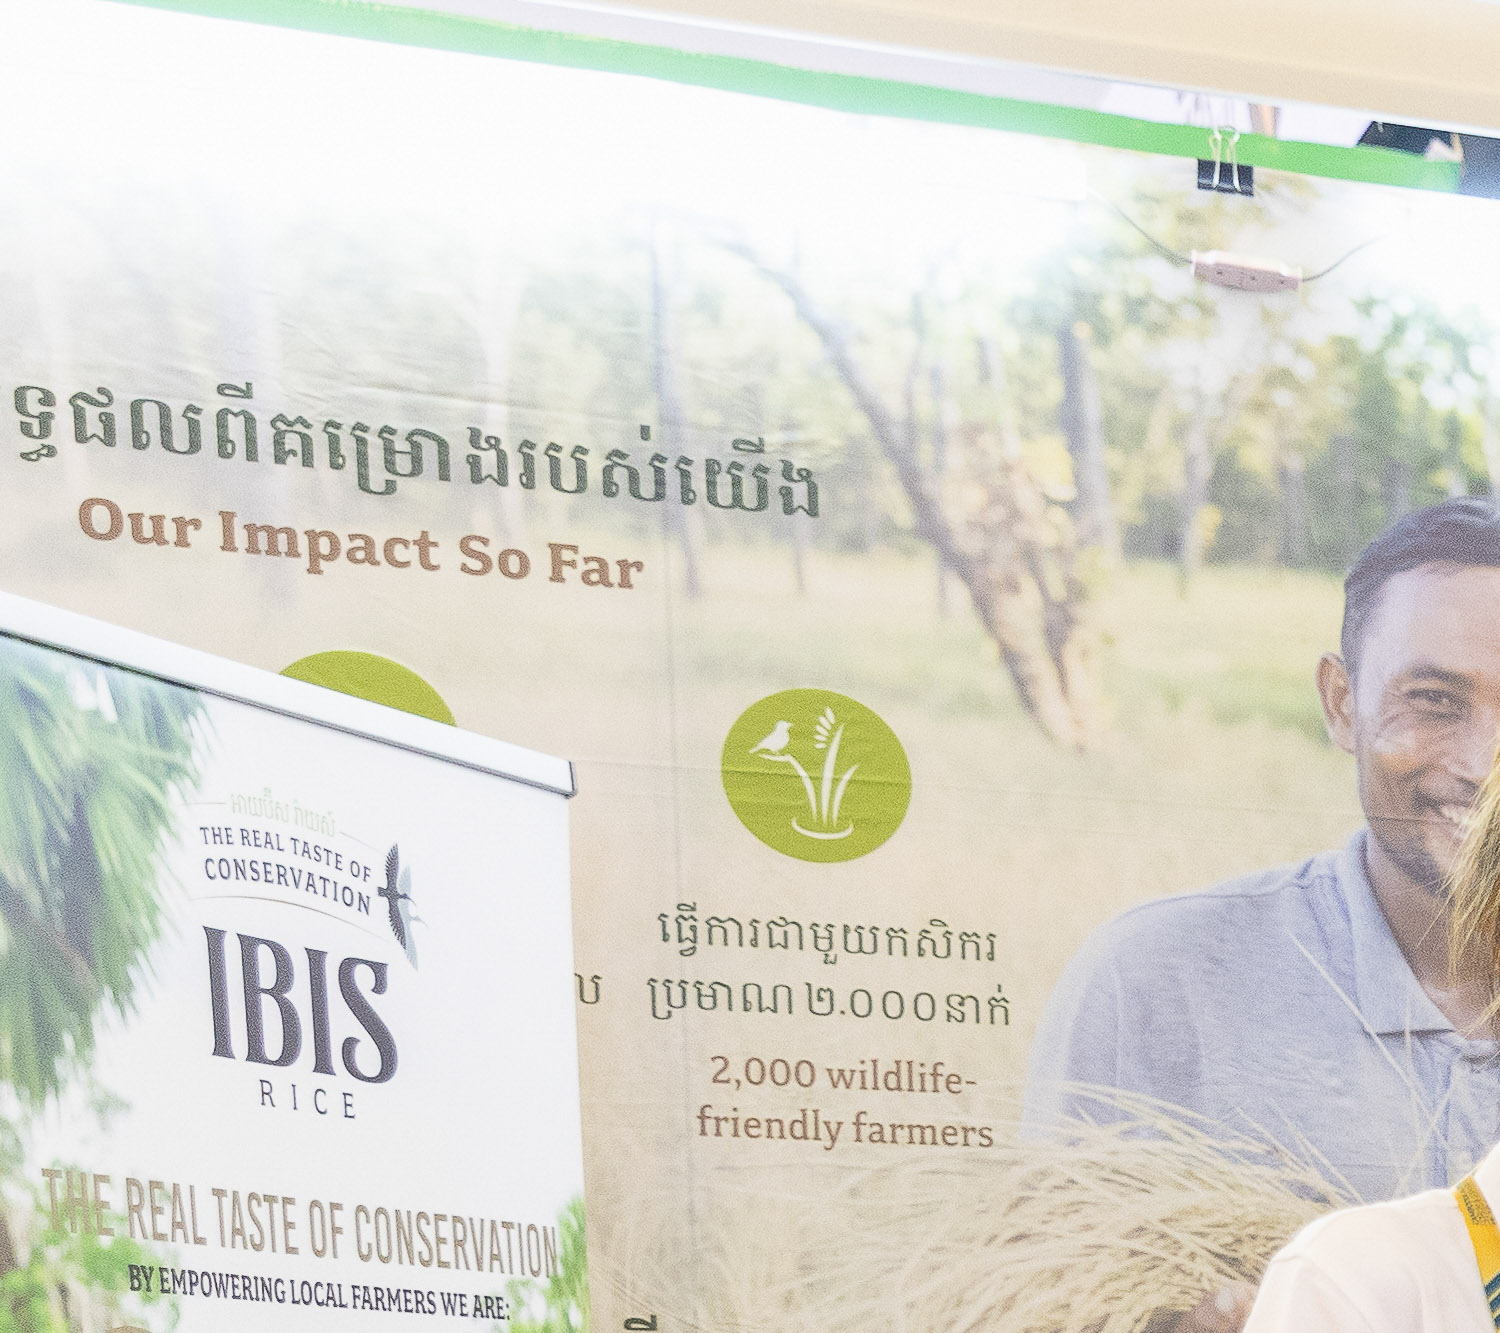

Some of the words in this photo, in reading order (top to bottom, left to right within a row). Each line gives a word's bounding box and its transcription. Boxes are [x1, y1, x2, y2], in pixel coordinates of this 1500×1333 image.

[77, 496, 202, 549] Our
[218, 508, 440, 575] Impact
[459, 534, 530, 582] So
[547, 543, 645, 591] Far
[200, 826, 233, 846] THE
[240, 827, 285, 854] REAL
[290, 837, 344, 872] TASTE
[350, 859, 373, 883] OF
[204, 857, 371, 917] CONSERVATION
[202, 925, 399, 1084] IBIS
[259, 1079, 357, 1120] RICE
[710, 1055, 816, 1091] 2,000
[825, 1058, 978, 1095] wildlife-
[697, 1104, 843, 1151] friendly
[852, 1110, 995, 1149] farmers
[42, 1167, 115, 1238] THE
[125, 1176, 208, 1246] REAL
[211, 1187, 300, 1256] TASTE
[308, 1198, 345, 1260] OF
[354, 1203, 560, 1279] CONSERVATION
[128, 1263, 156, 1293] BY
[160, 1266, 286, 1305] EMPOWERING
[290, 1278, 349, 1310] LOCAL
[352, 1284, 437, 1316] FARMERS
[442, 1291, 470, 1319] WE
[472, 1293, 511, 1321] ARE:
